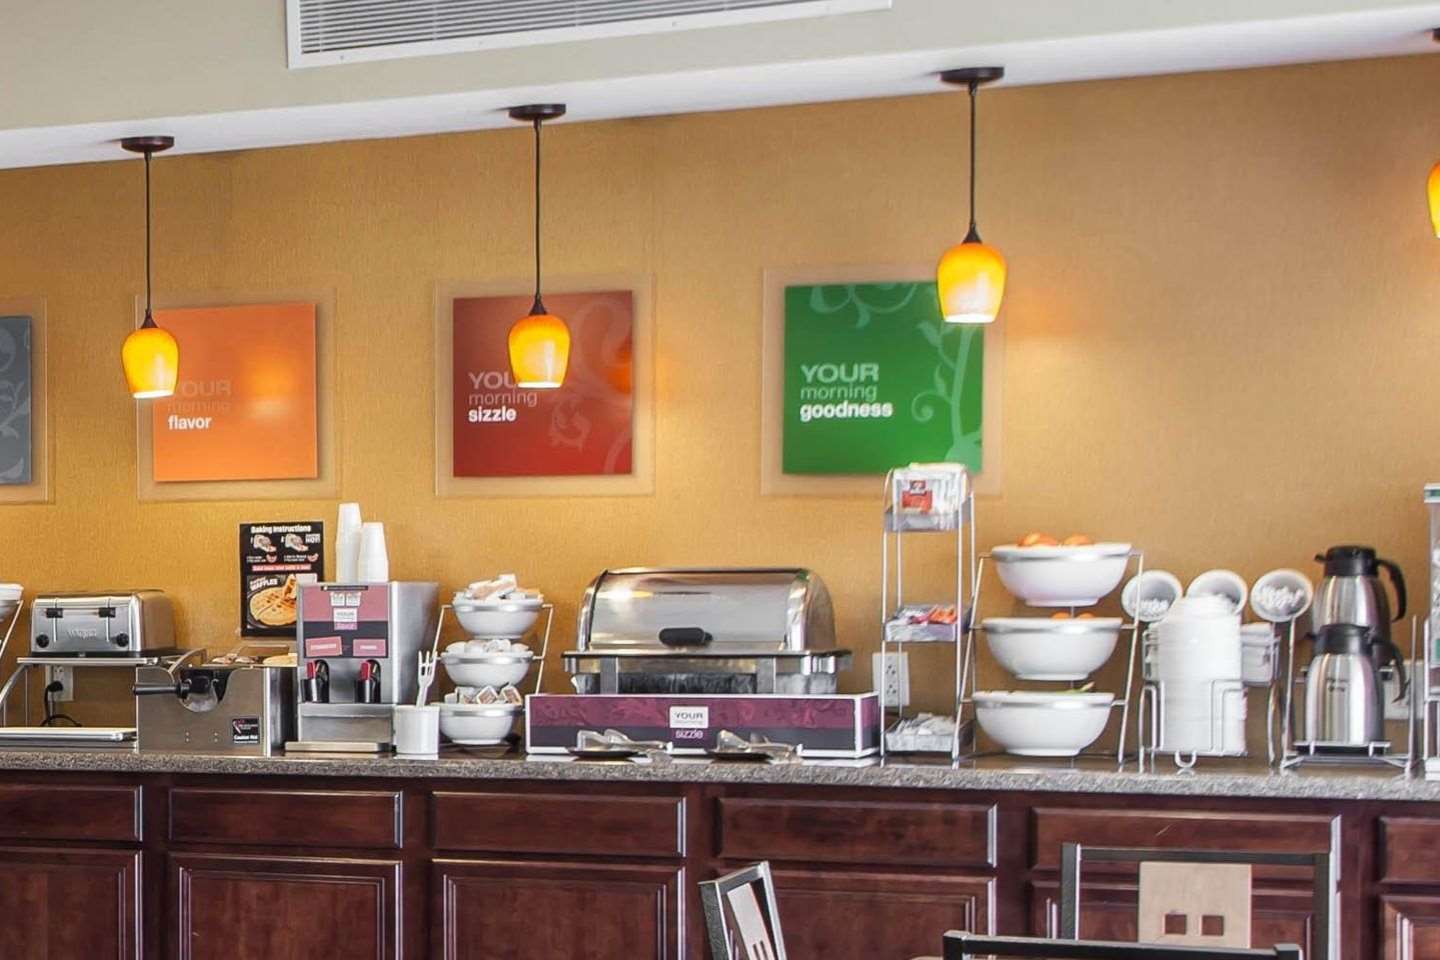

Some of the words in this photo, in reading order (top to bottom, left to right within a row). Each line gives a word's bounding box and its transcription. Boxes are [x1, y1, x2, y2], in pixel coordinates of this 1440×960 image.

[468, 371, 516, 390] YOU
[801, 363, 879, 383] YOUR
[175, 379, 231, 397] OUR
[800, 384, 877, 403] morning
[468, 389, 537, 407] morning
[468, 405, 517, 422] sizzle
[800, 400, 893, 422] goodness
[168, 414, 212, 430] flavor
